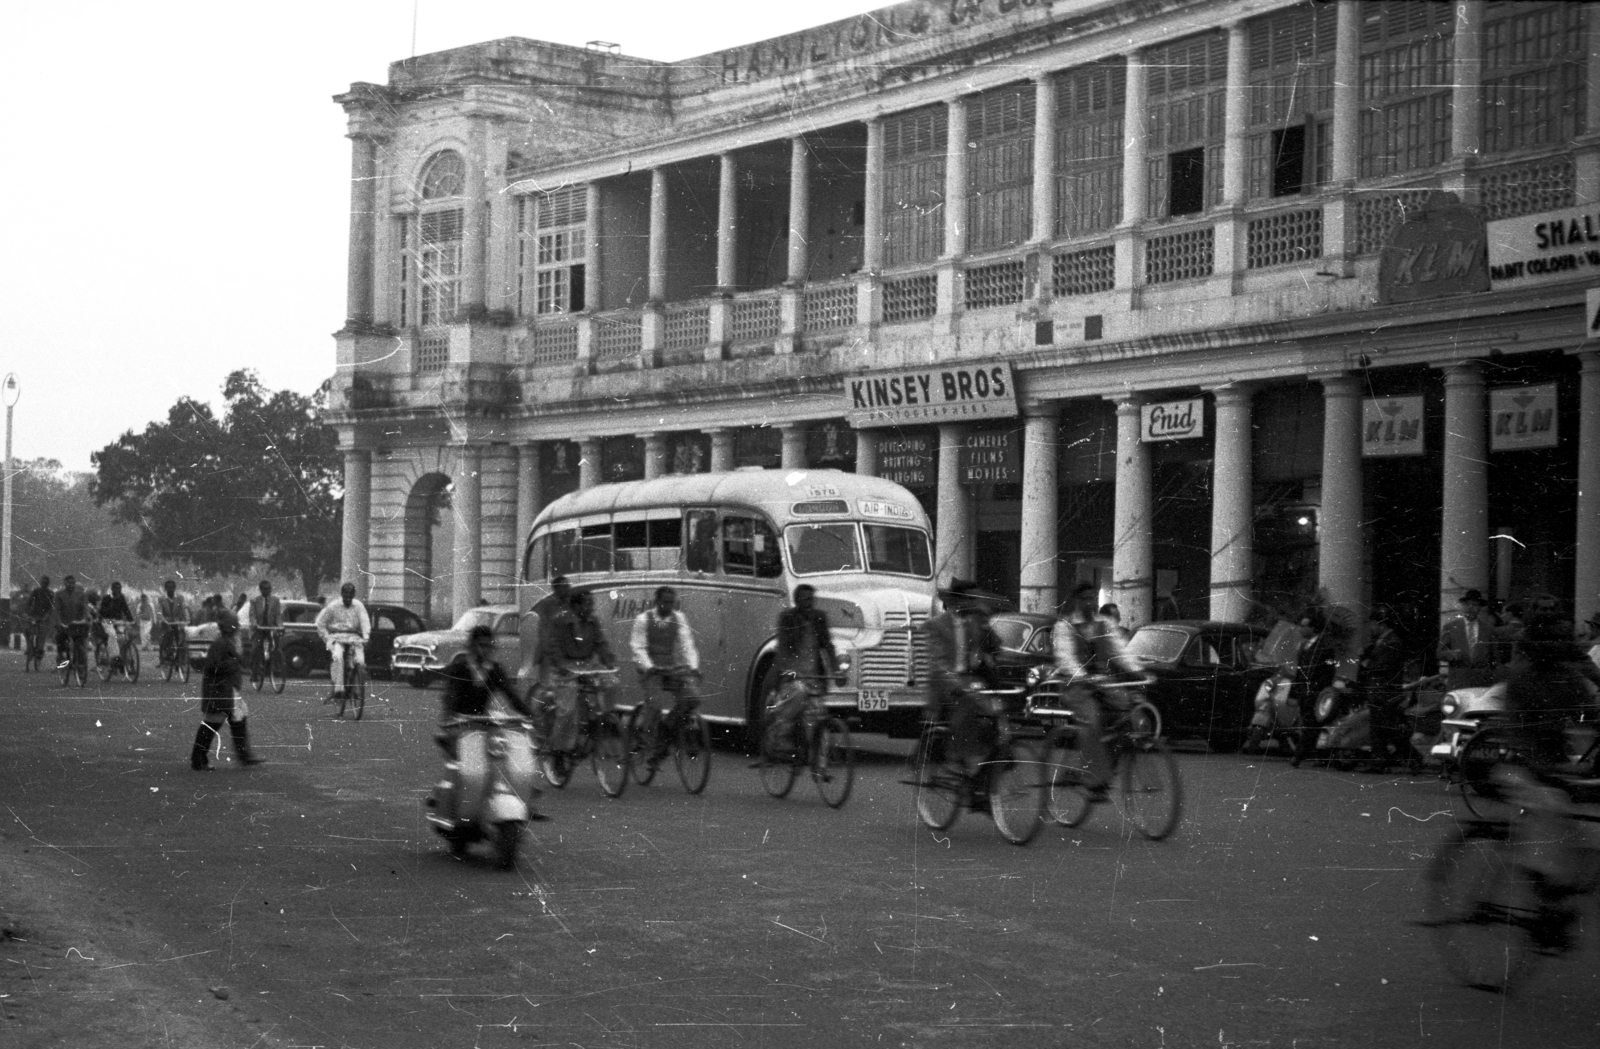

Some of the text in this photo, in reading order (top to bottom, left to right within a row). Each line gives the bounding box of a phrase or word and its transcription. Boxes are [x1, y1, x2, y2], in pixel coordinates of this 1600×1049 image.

[1535, 213, 1600, 250] SHAL
[1394, 239, 1479, 285] KLM
[851, 374, 931, 408] KINSEY
[869, 404, 987, 420] PHOTOGRAPHERS
[1148, 402, 1196, 437] Enid
[1495, 408, 1553, 436] KLM
[966, 434, 1008, 448] CAMERAS
[1365, 419, 1420, 442] KLM
[971, 450, 1004, 464] FILMS
[967, 466, 1008, 480] MOVIES
[860, 699, 887, 709] 1570
